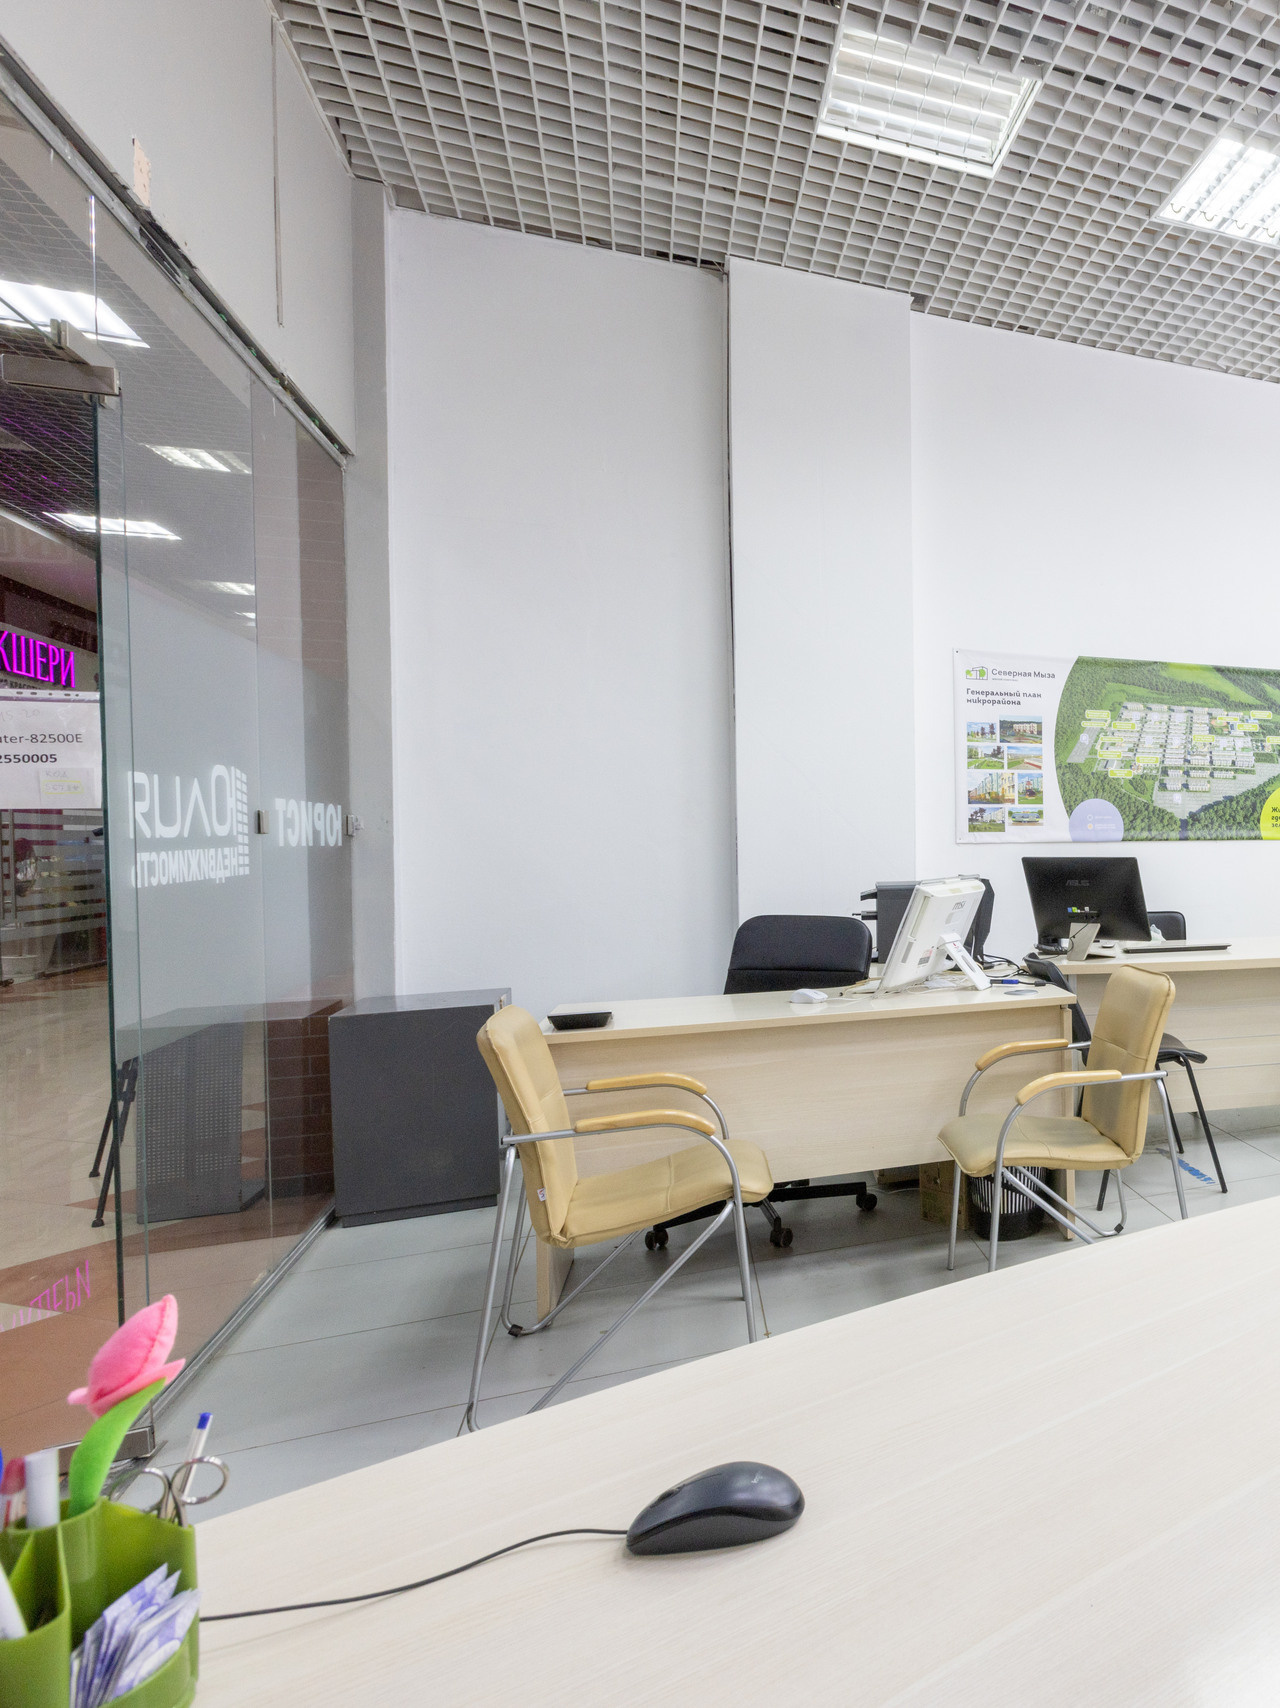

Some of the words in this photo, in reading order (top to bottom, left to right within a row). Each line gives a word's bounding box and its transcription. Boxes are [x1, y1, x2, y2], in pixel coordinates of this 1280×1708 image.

[991, 668, 1032, 678] Северная
[1033, 670, 1056, 679] Мыза
[966, 688, 1021, 698] Генеральный
[966, 697, 1021, 706] микрорайона
[0, 733, 84, 745] ter-82500E
